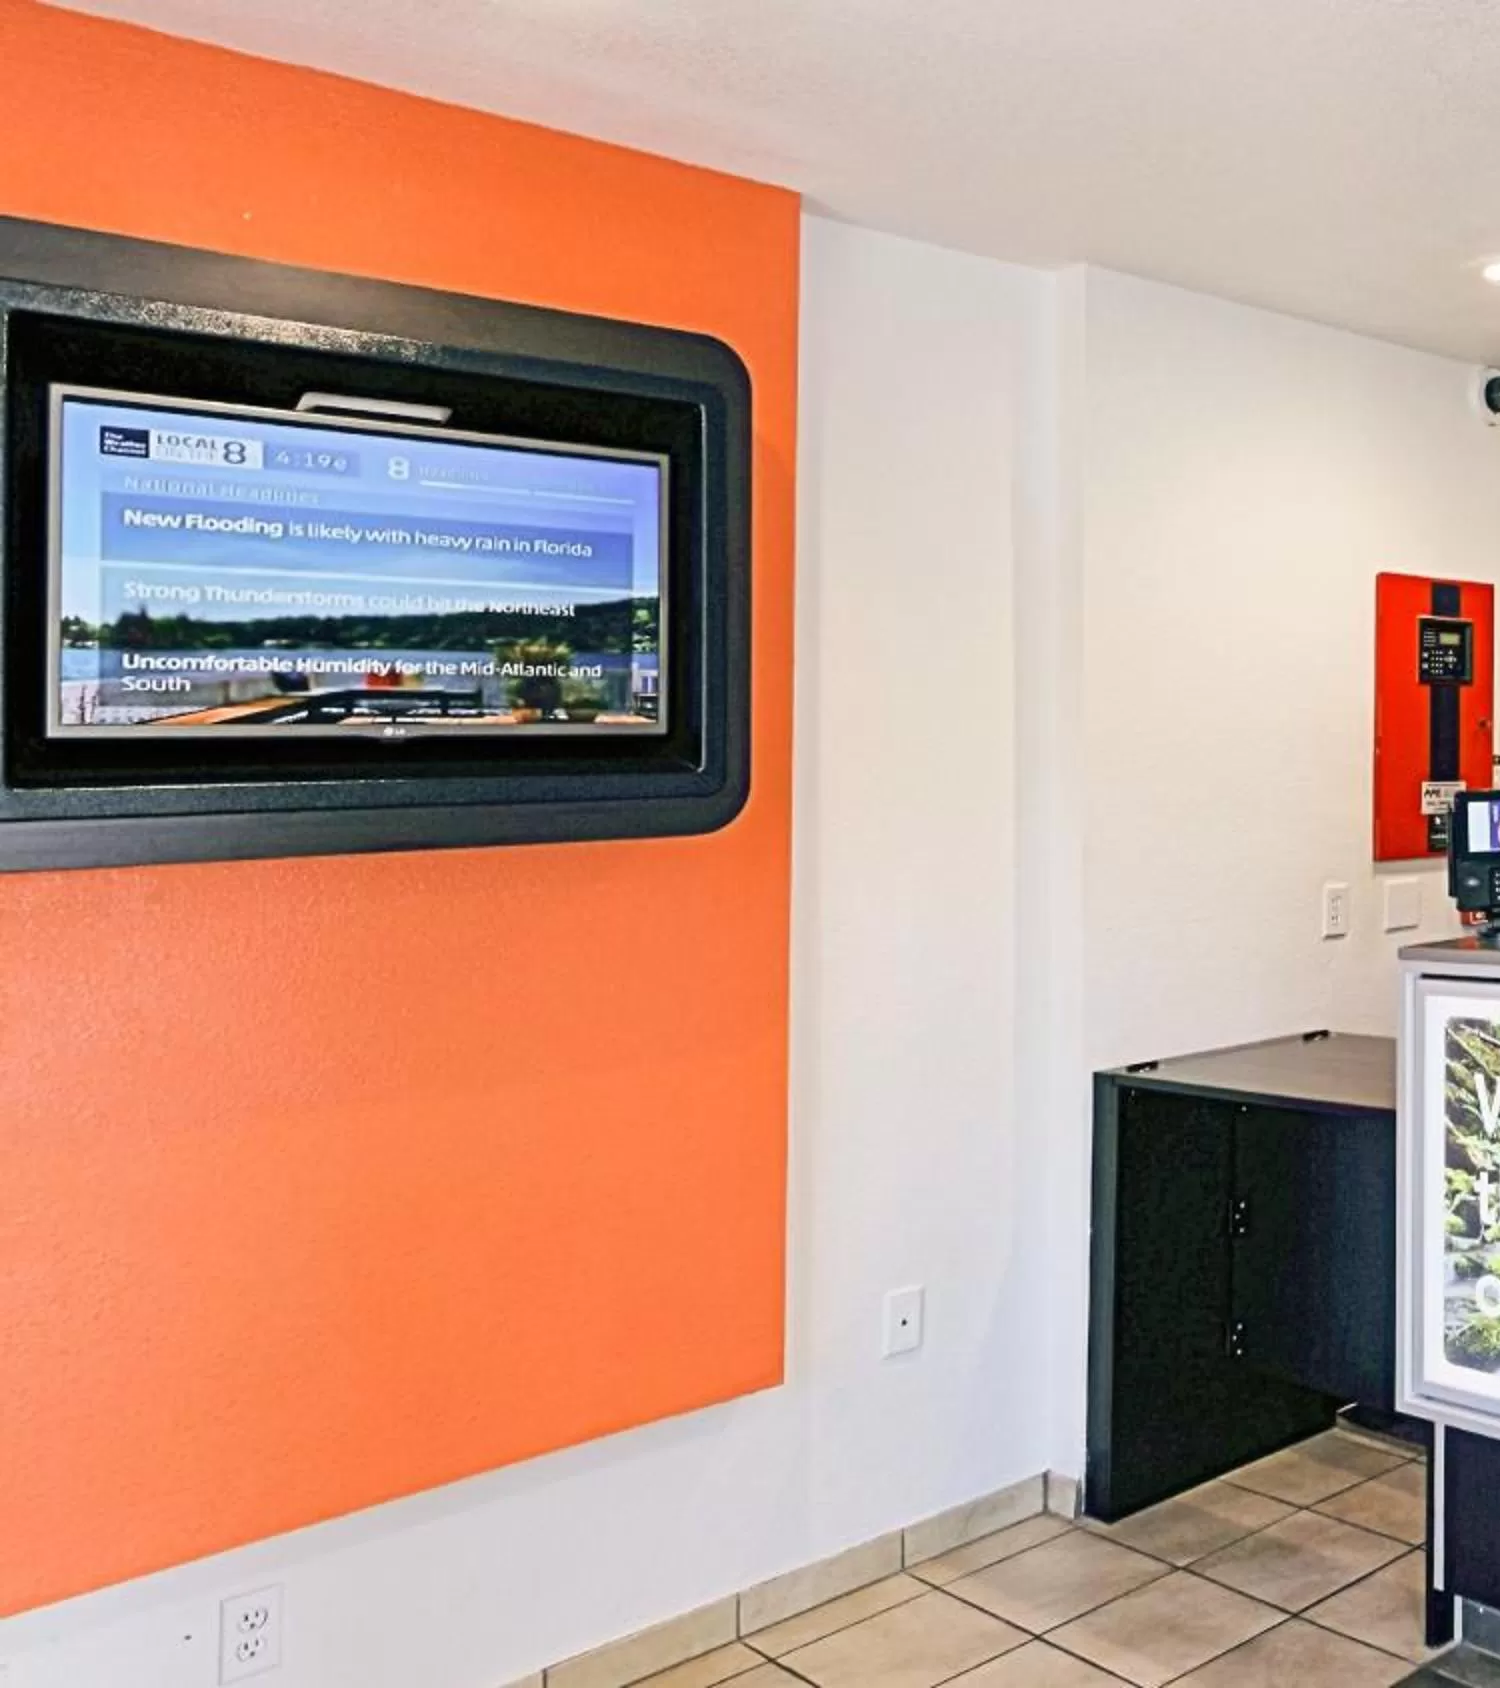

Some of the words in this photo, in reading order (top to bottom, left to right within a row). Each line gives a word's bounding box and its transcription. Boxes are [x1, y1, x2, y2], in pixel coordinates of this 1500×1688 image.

[157, 434, 218, 450] LOCAL
[222, 441, 247, 465] 8
[387, 456, 410, 480] 8
[123, 508, 181, 528] New
[185, 513, 283, 538] Flooding
[288, 520, 304, 537] is
[307, 522, 361, 544] likely
[365, 528, 411, 545] with
[415, 530, 472, 551] heavy
[475, 535, 511, 552] rain
[513, 537, 530, 553] in
[533, 538, 593, 558] Florida
[124, 580, 199, 605] Strong
[122, 652, 293, 673] Uncomfortable
[296, 656, 391, 677] Humidity
[395, 658, 424, 675] for
[425, 660, 460, 676] the
[460, 661, 567, 678] Mid-Atlantic
[569, 663, 603, 678] and
[121, 676, 192, 693] South
